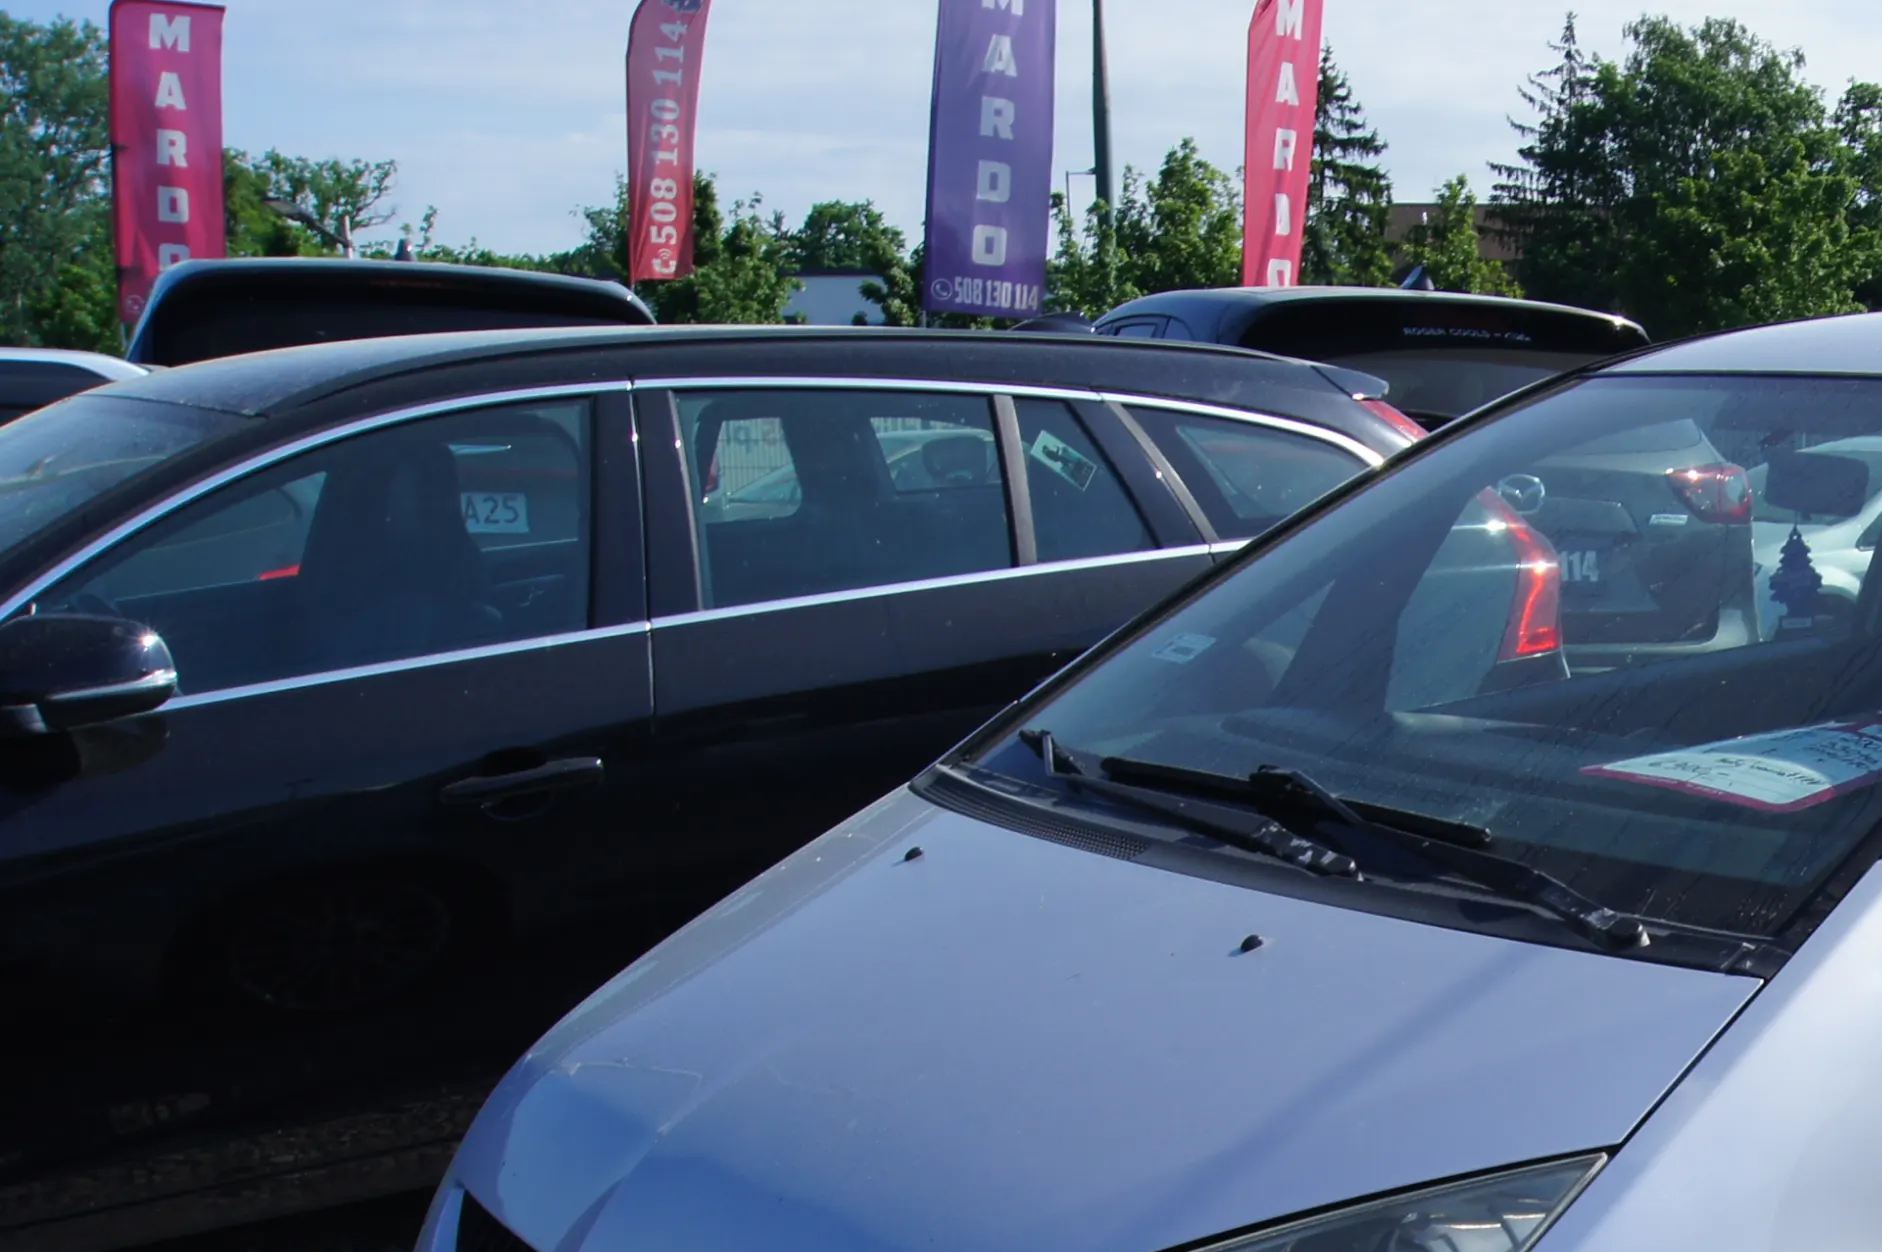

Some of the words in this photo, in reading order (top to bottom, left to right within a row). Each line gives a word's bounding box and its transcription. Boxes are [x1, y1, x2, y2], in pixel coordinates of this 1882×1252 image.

[652, 20, 688, 87] 114
[651, 98, 681, 167] 130
[650, 176, 678, 245] 508
[954, 276, 983, 305] 508
[986, 279, 1012, 309] 130
[1014, 282, 1040, 311] 114
